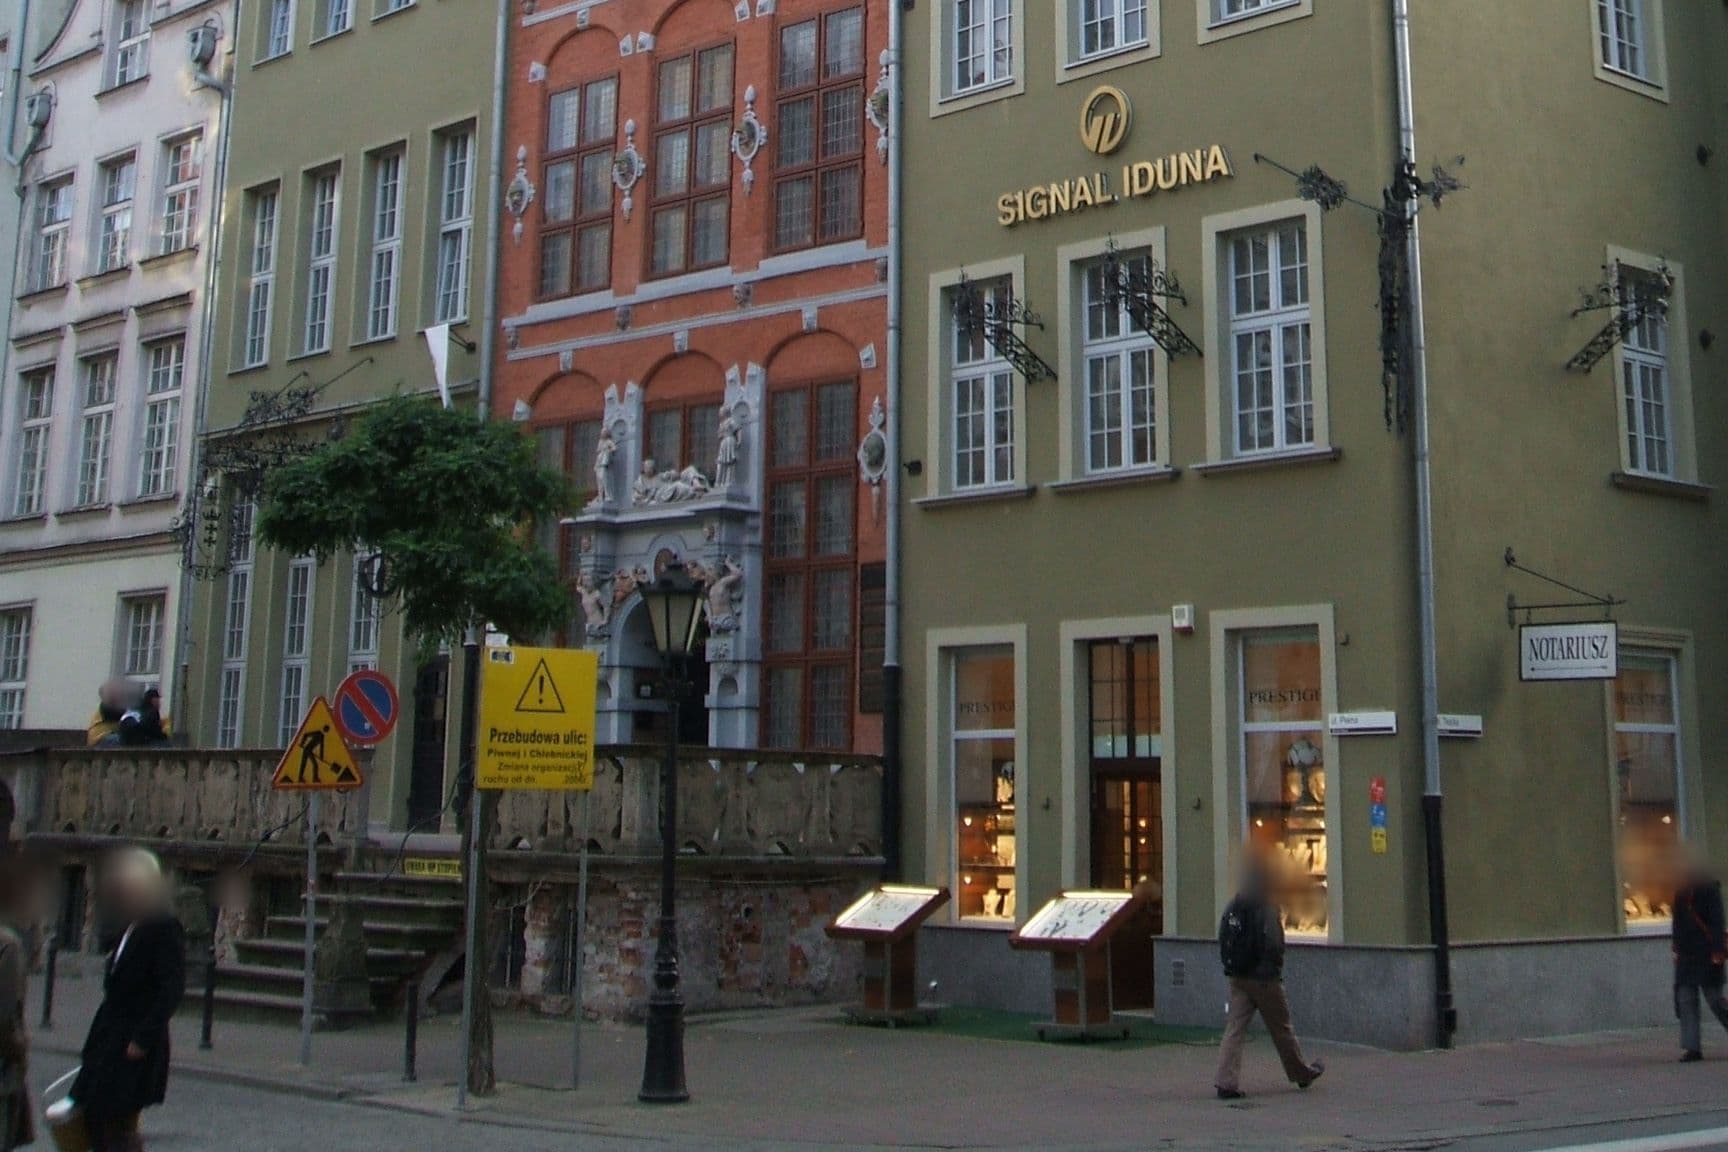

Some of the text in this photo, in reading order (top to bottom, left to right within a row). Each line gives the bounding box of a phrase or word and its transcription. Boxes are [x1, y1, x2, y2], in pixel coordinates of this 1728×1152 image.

[998, 144, 1231, 226] SIGNAL IDUNA
[1529, 635, 1608, 662] NOTARIUSZ
[489, 728, 587, 745] Przebudowa ulic:
[487, 749, 521, 759] Piwnej
